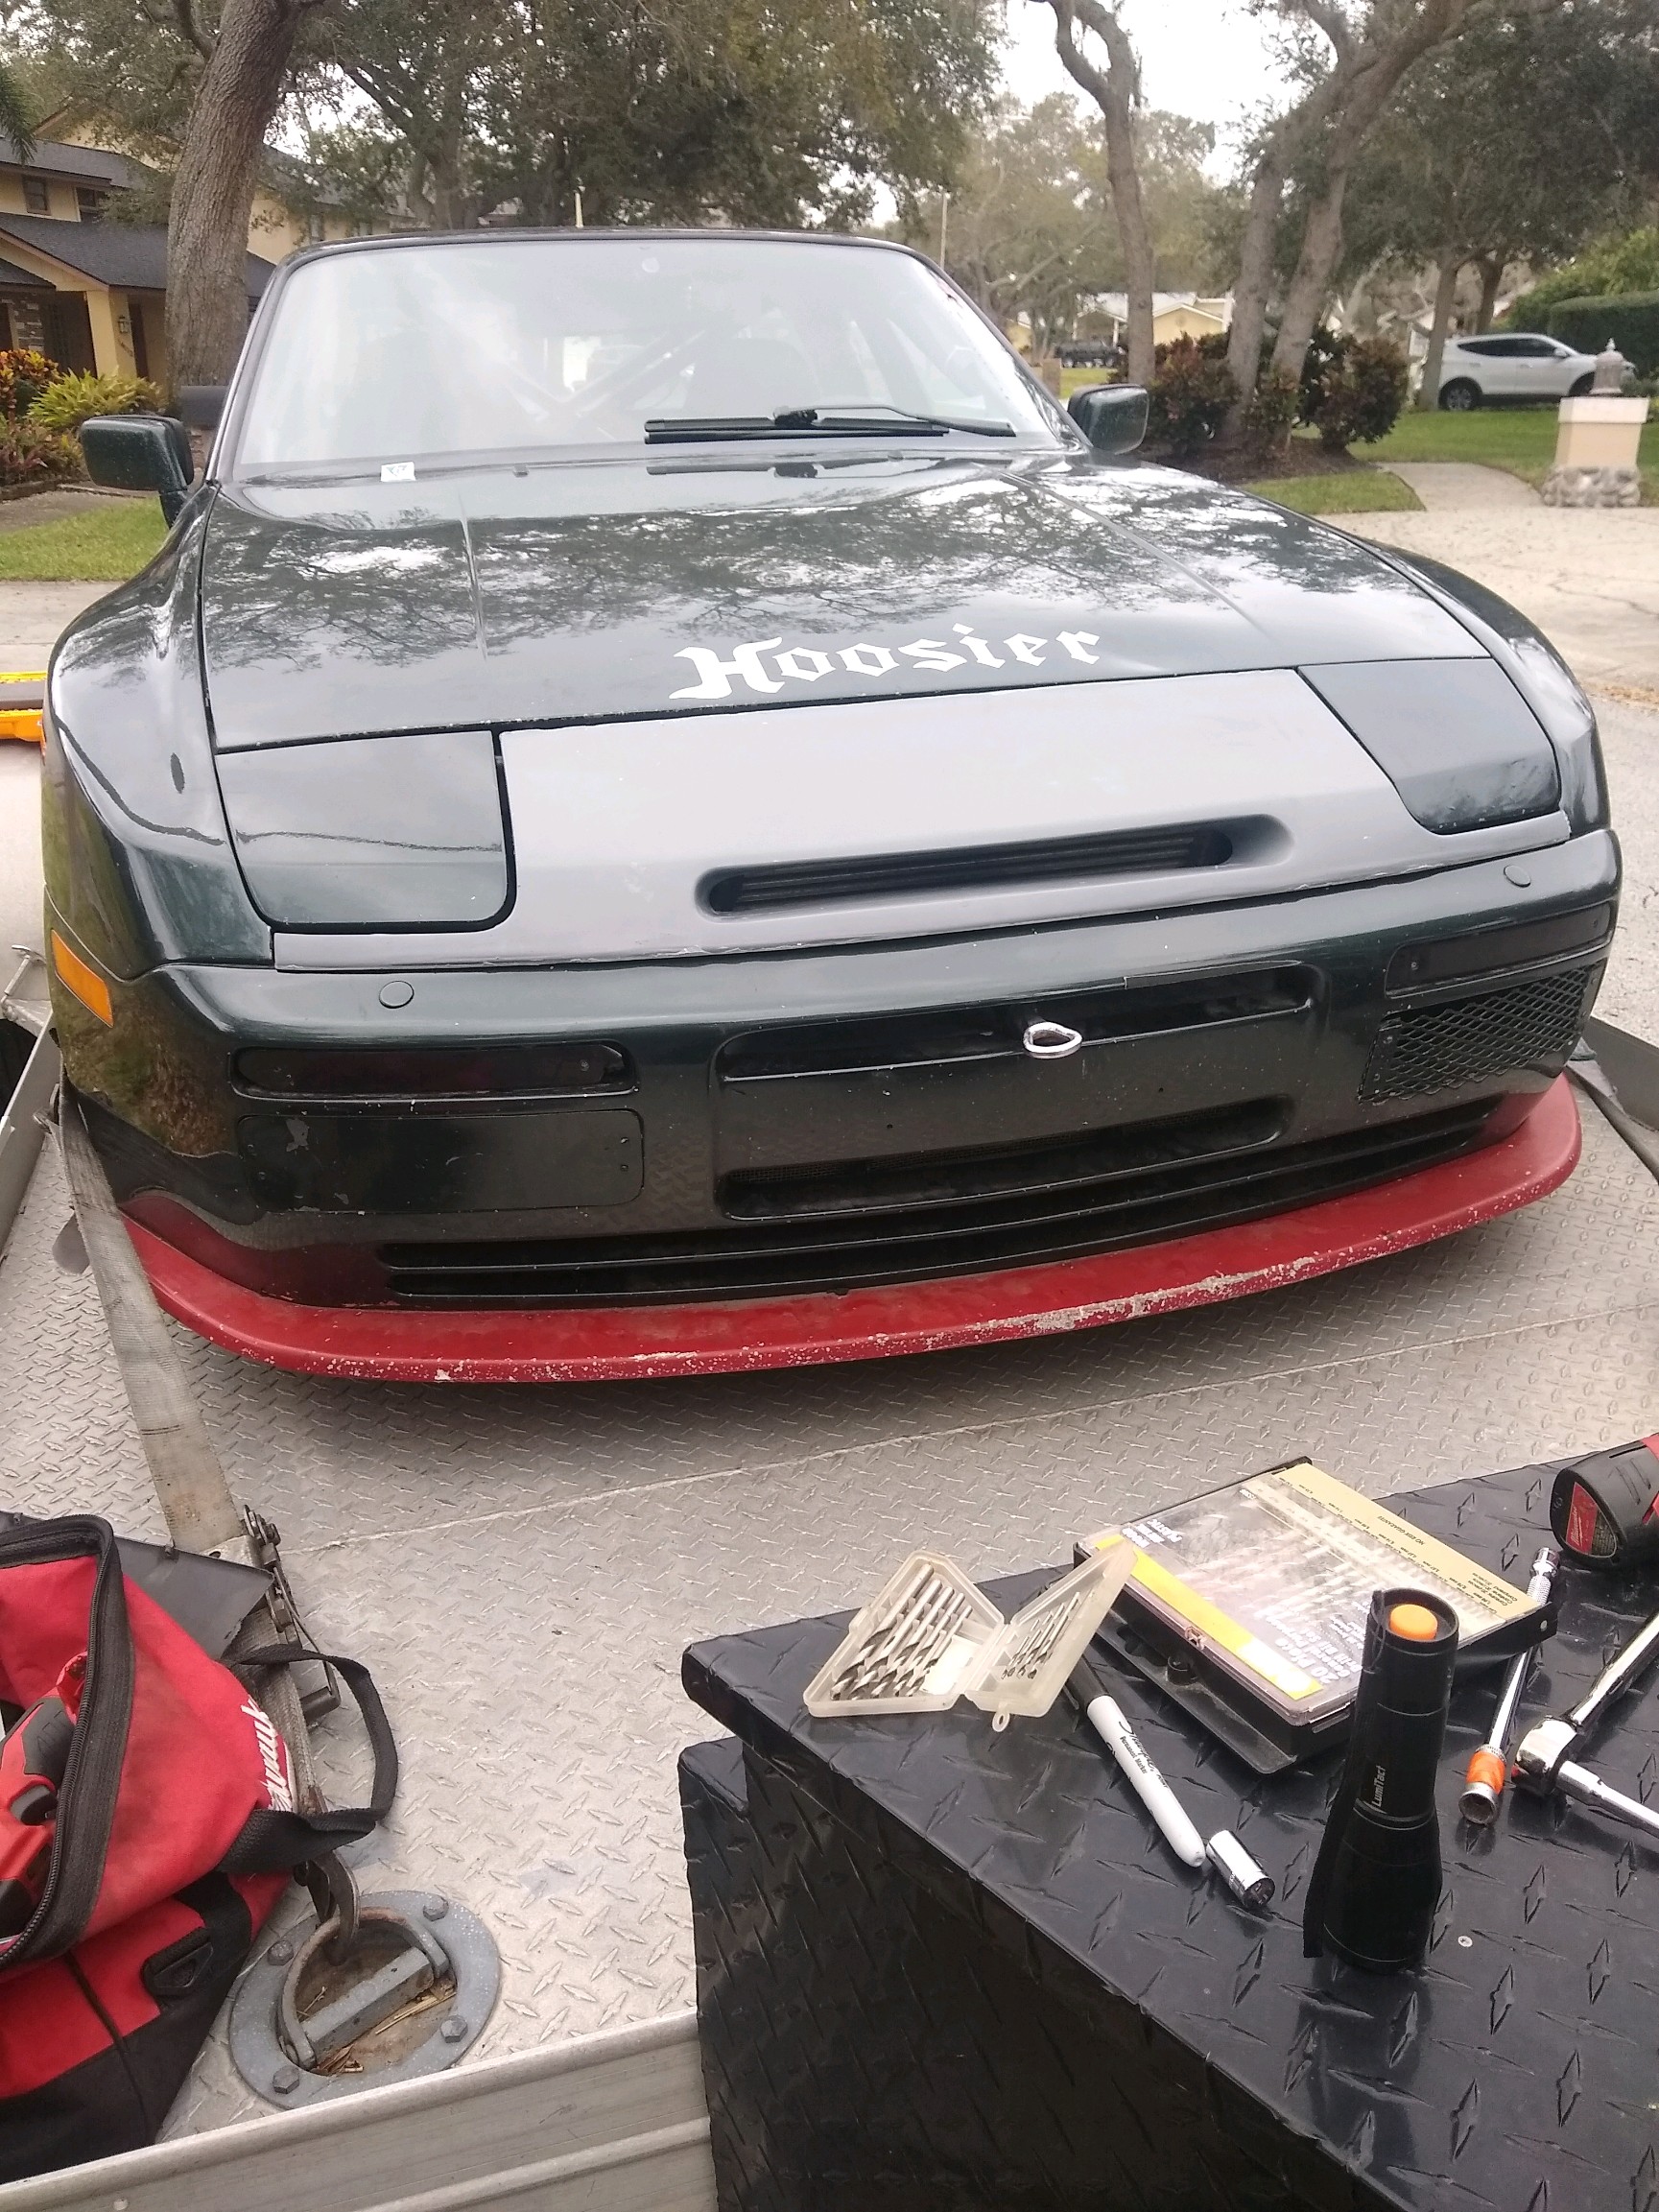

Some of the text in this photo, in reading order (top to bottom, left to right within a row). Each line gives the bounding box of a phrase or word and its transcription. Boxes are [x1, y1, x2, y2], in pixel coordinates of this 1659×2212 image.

[668, 623, 1101, 700] Hoosier
[1146, 1518, 1183, 1543] PLASTIC
[1274, 1637, 1339, 1684] 20 Piece
[1302, 1645, 1351, 1677] General
[1317, 1641, 1339, 1655] Bit
[1333, 1653, 1363, 1673] Drill
[1120, 1736, 1148, 1774] Permanent Marker
[1371, 1765, 1386, 1807] LumiTact
